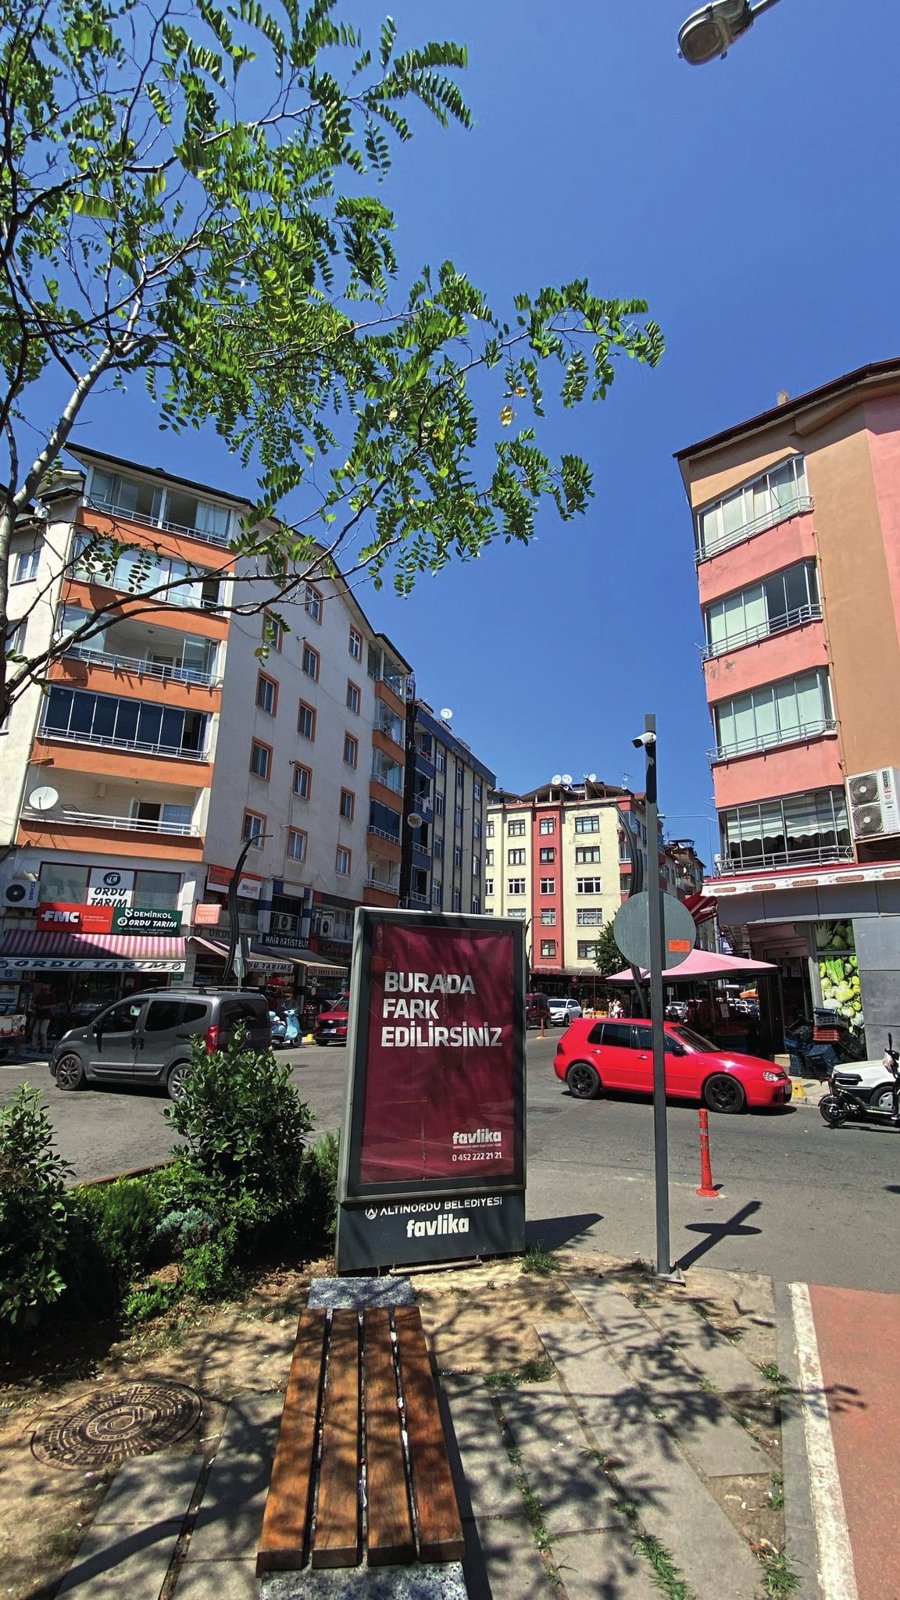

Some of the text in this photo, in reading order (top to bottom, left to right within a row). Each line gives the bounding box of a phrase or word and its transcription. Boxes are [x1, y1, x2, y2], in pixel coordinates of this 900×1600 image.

[94, 887, 127, 896] ORDU
[90, 897, 128, 908] TARIM
[41, 910, 80, 923] FMC
[133, 910, 172, 919] DEMİRKOL
[152, 920, 178, 928] TARIM
[14, 959, 167, 970] ORDU TARIM
[384, 971, 476, 994] BURADA
[382, 998, 440, 1019] FARK
[381, 1020, 503, 1047] EDİLİRSİNİZ
[452, 1128, 502, 1144] favlika
[452, 1151, 502, 1162] 0 452 222 21 21
[406, 1213, 470, 1238] favlika
